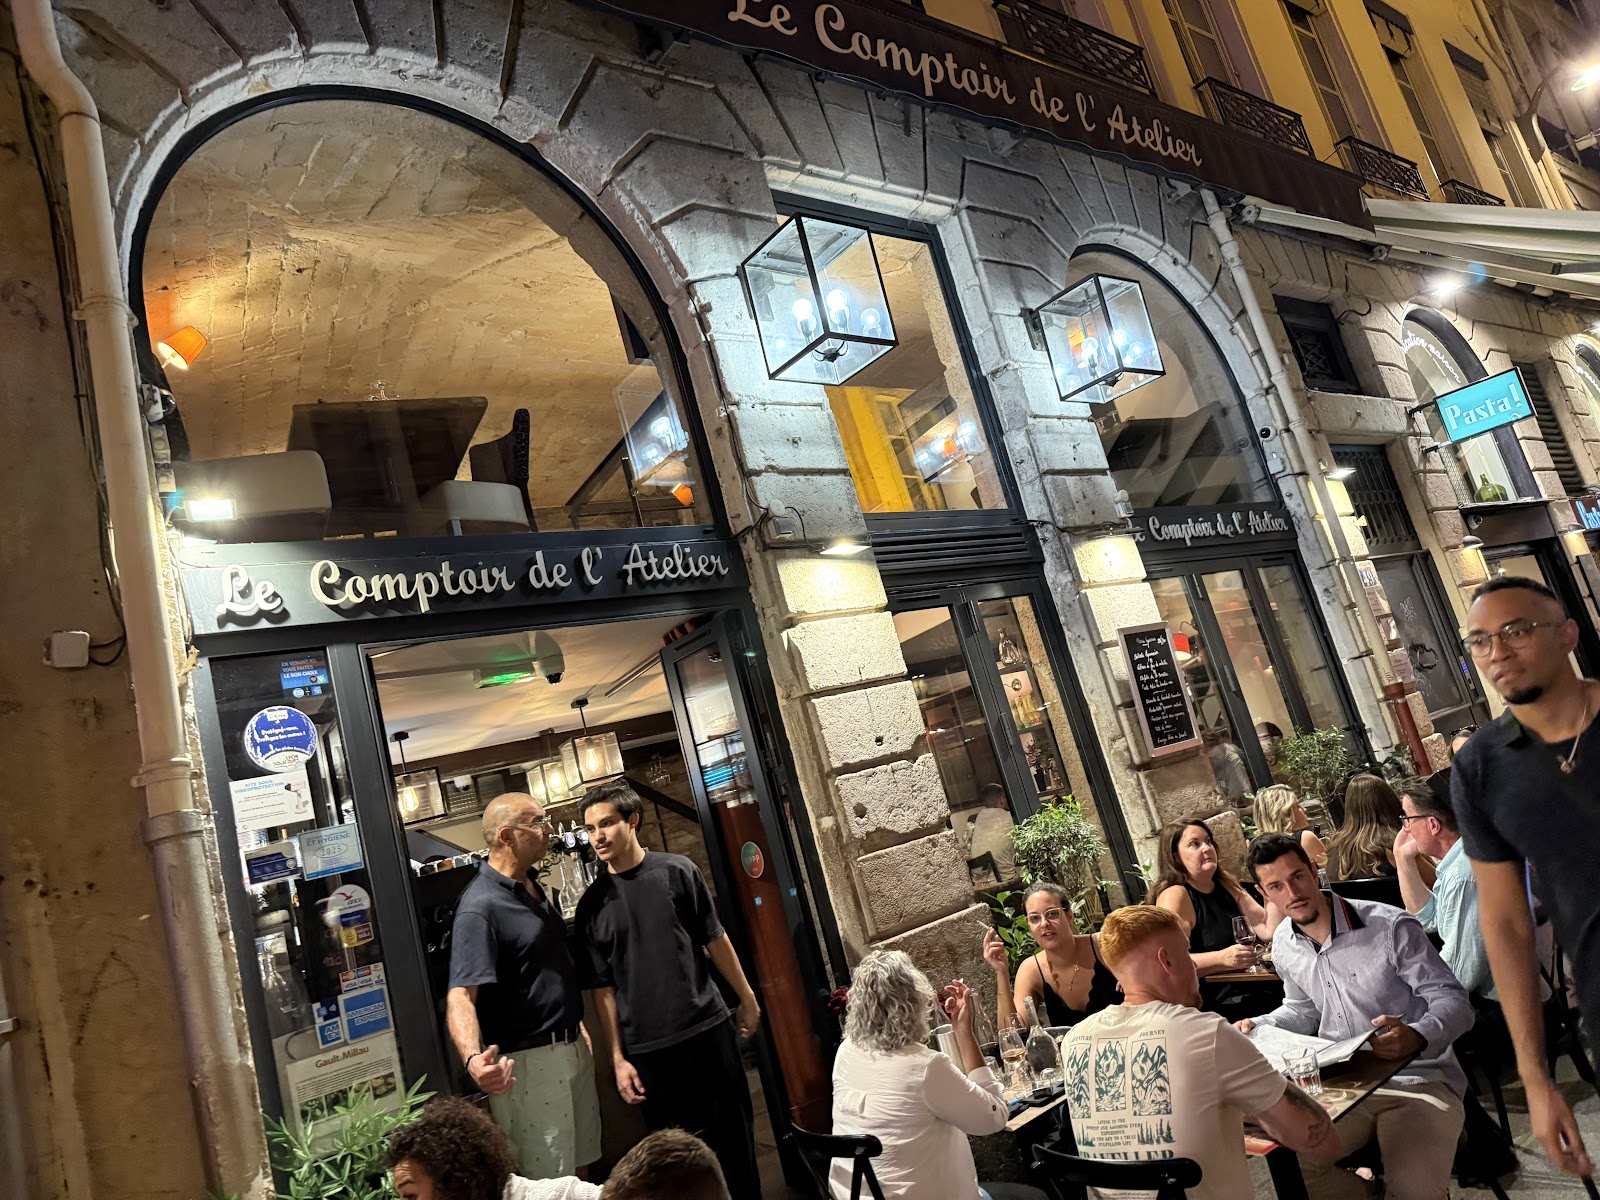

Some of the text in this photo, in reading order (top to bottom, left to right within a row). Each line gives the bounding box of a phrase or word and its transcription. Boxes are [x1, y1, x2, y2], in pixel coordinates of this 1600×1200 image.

[728, 0, 1203, 167] Le Comptoir de l' Atelier
[1148, 515, 1216, 547] Comptoir
[1216, 512, 1235, 538] de
[1248, 509, 1289, 535] Atelier
[216, 542, 730, 614] Le Comptoir de l' Atelier
[321, 844, 342, 857] 2025
[346, 1001, 386, 1019] AMERICAN
[1138, 1029, 1166, 1038] JOURNEY
